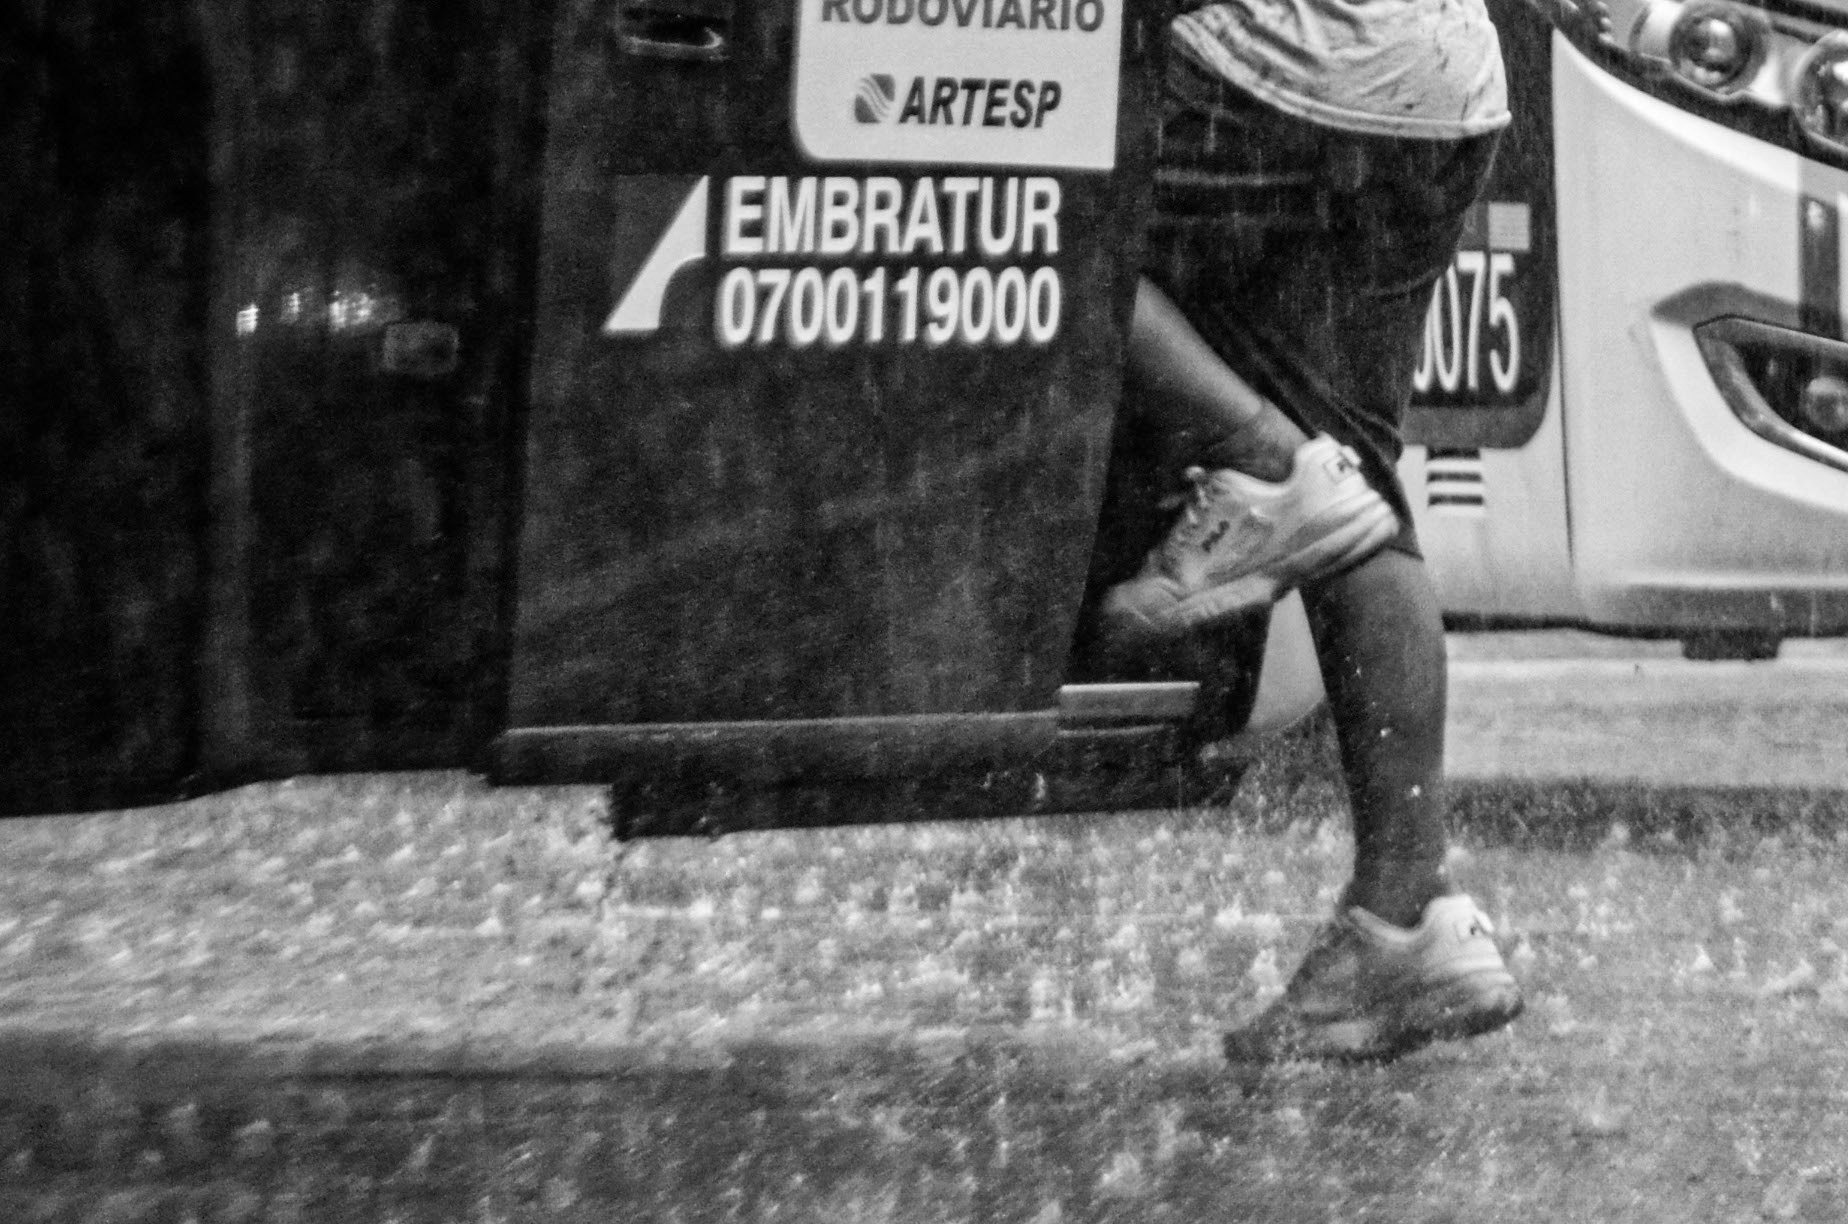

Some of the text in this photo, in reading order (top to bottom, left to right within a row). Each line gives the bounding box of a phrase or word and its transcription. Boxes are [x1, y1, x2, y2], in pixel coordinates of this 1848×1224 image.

[898, 74, 1063, 130] ARTESP
[723, 175, 1064, 257] EMBRATUR
[717, 265, 1062, 346] 0700119000
[1412, 249, 1522, 396] 075
